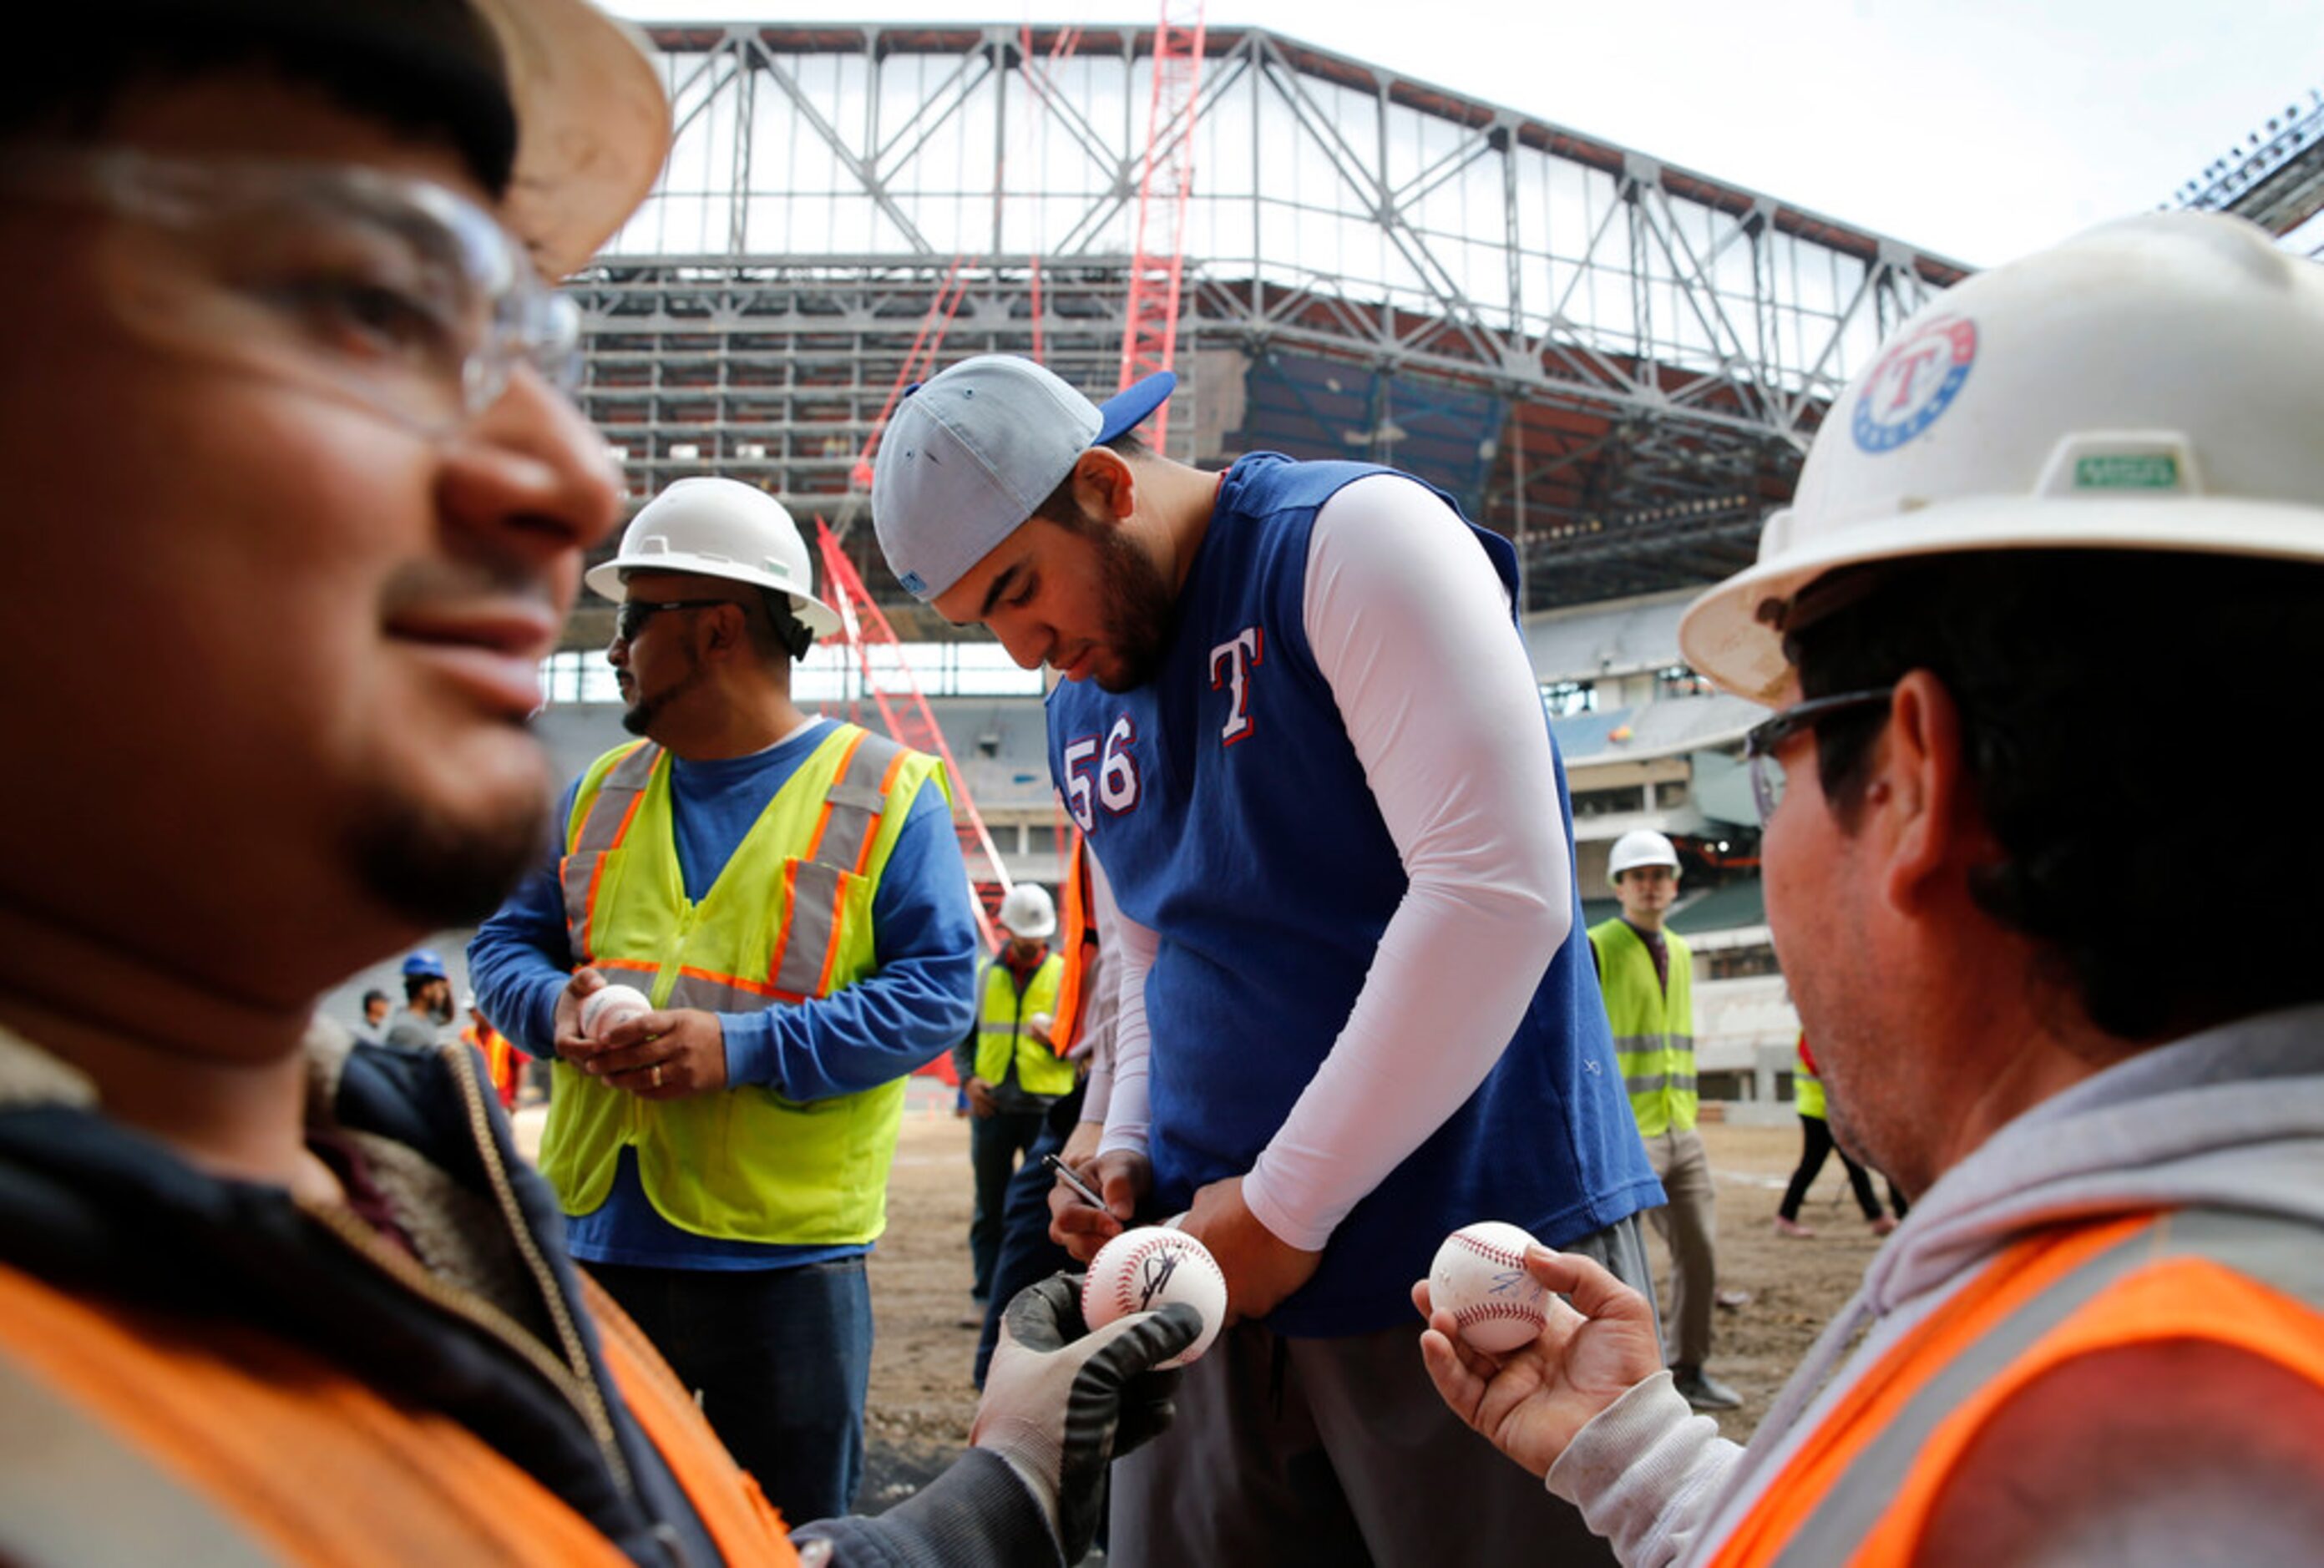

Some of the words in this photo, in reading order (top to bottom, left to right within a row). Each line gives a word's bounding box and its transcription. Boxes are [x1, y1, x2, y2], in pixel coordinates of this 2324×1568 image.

[1890, 345, 1939, 412] T
[1209, 626, 1263, 747] T
[1064, 713, 1142, 836] 56
